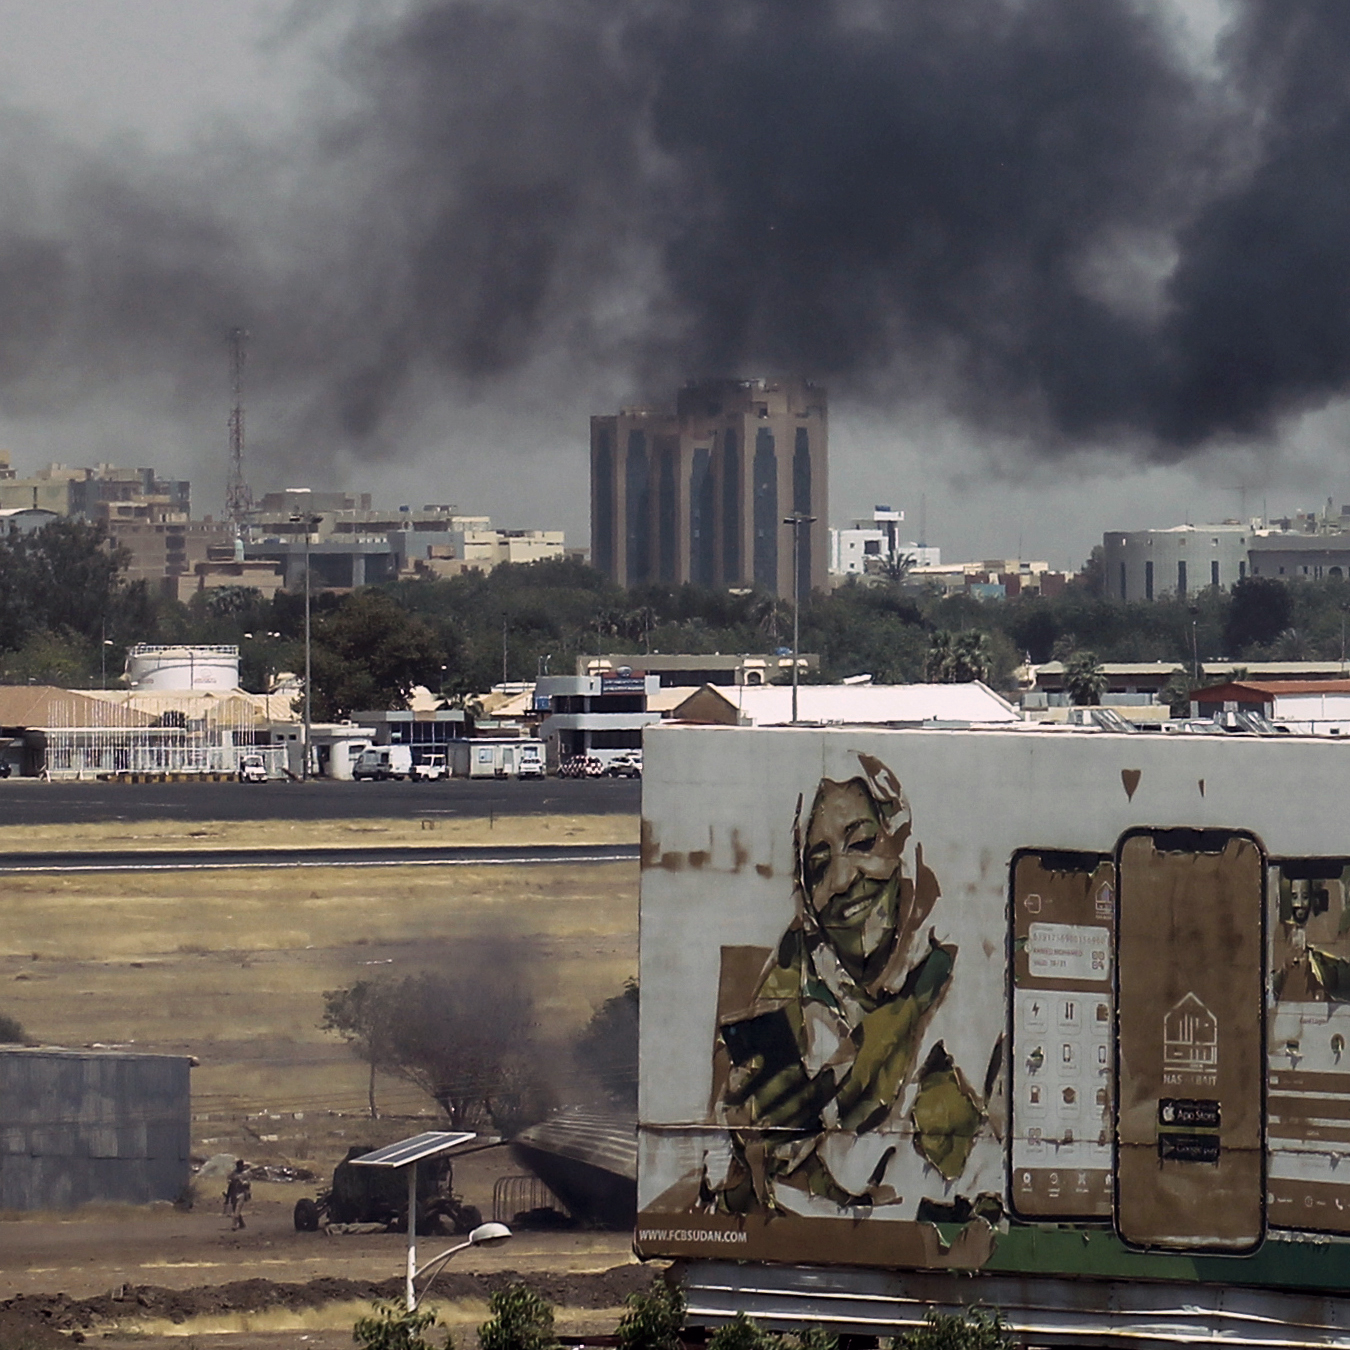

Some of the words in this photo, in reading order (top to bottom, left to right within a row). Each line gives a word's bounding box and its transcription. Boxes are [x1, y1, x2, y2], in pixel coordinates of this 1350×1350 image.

[1177, 1109, 1194, 1121] App
[1195, 1109, 1217, 1121] Store
[639, 1230, 748, 1243] WWW.FCBSUDAN.COM
